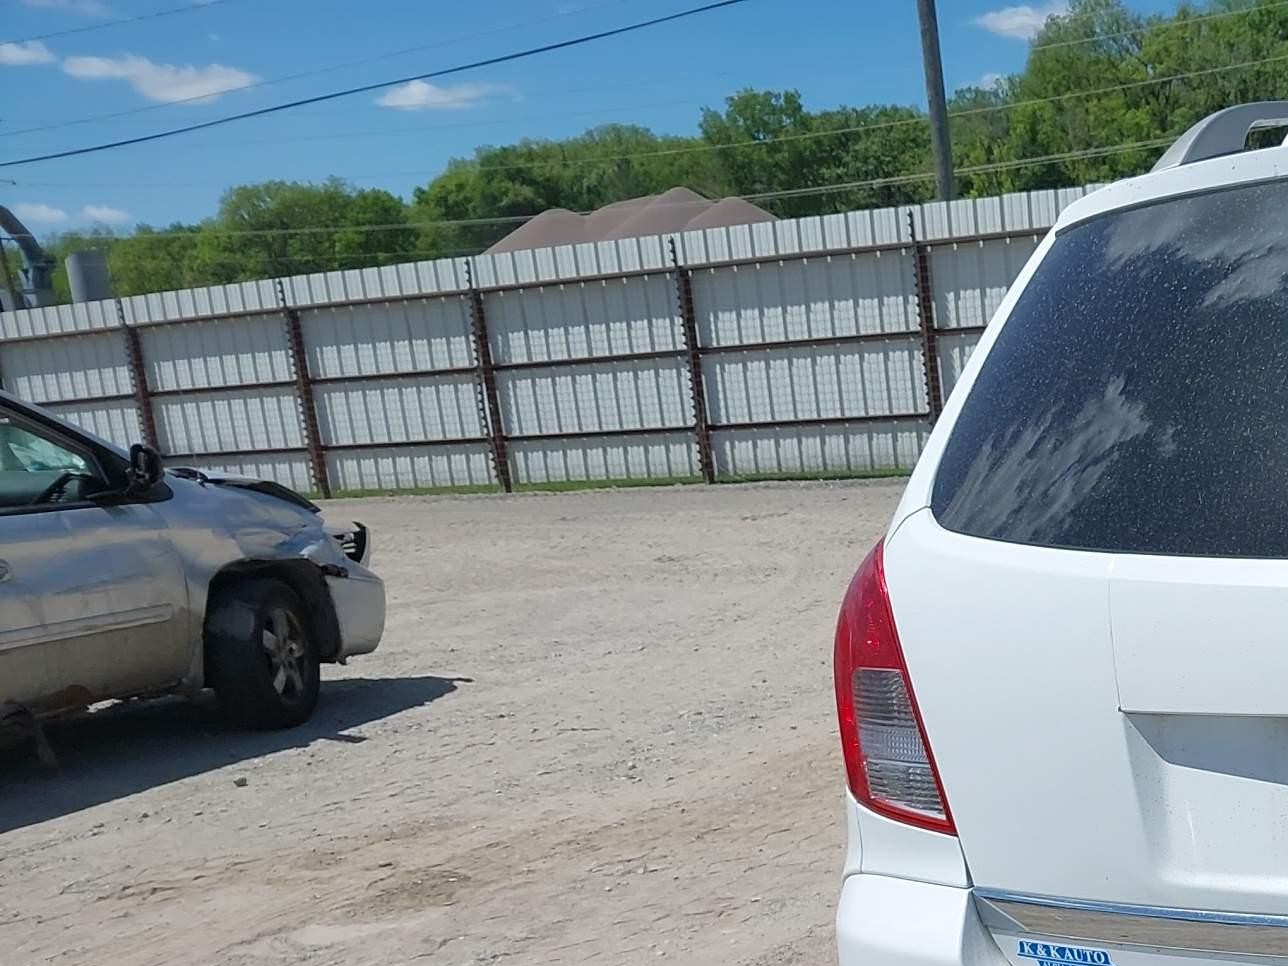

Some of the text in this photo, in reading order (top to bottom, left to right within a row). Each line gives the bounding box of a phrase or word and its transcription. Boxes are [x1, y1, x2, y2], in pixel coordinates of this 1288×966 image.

[1023, 941, 1106, 964] K & K AUTO
